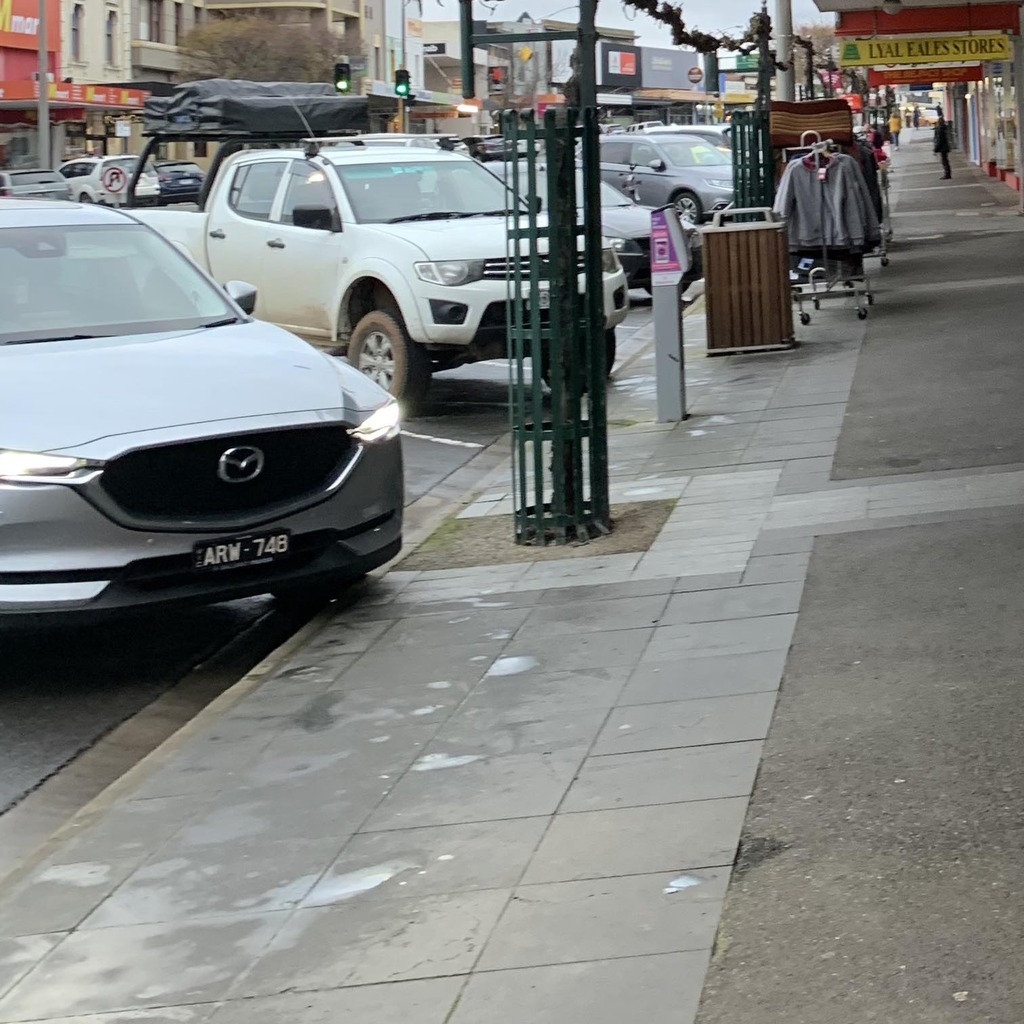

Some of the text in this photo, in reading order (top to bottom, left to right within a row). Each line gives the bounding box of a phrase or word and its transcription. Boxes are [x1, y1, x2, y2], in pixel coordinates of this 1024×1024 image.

[868, 42, 904, 59] LYAL
[907, 40, 951, 57] EALES
[952, 37, 1006, 55] STORES
